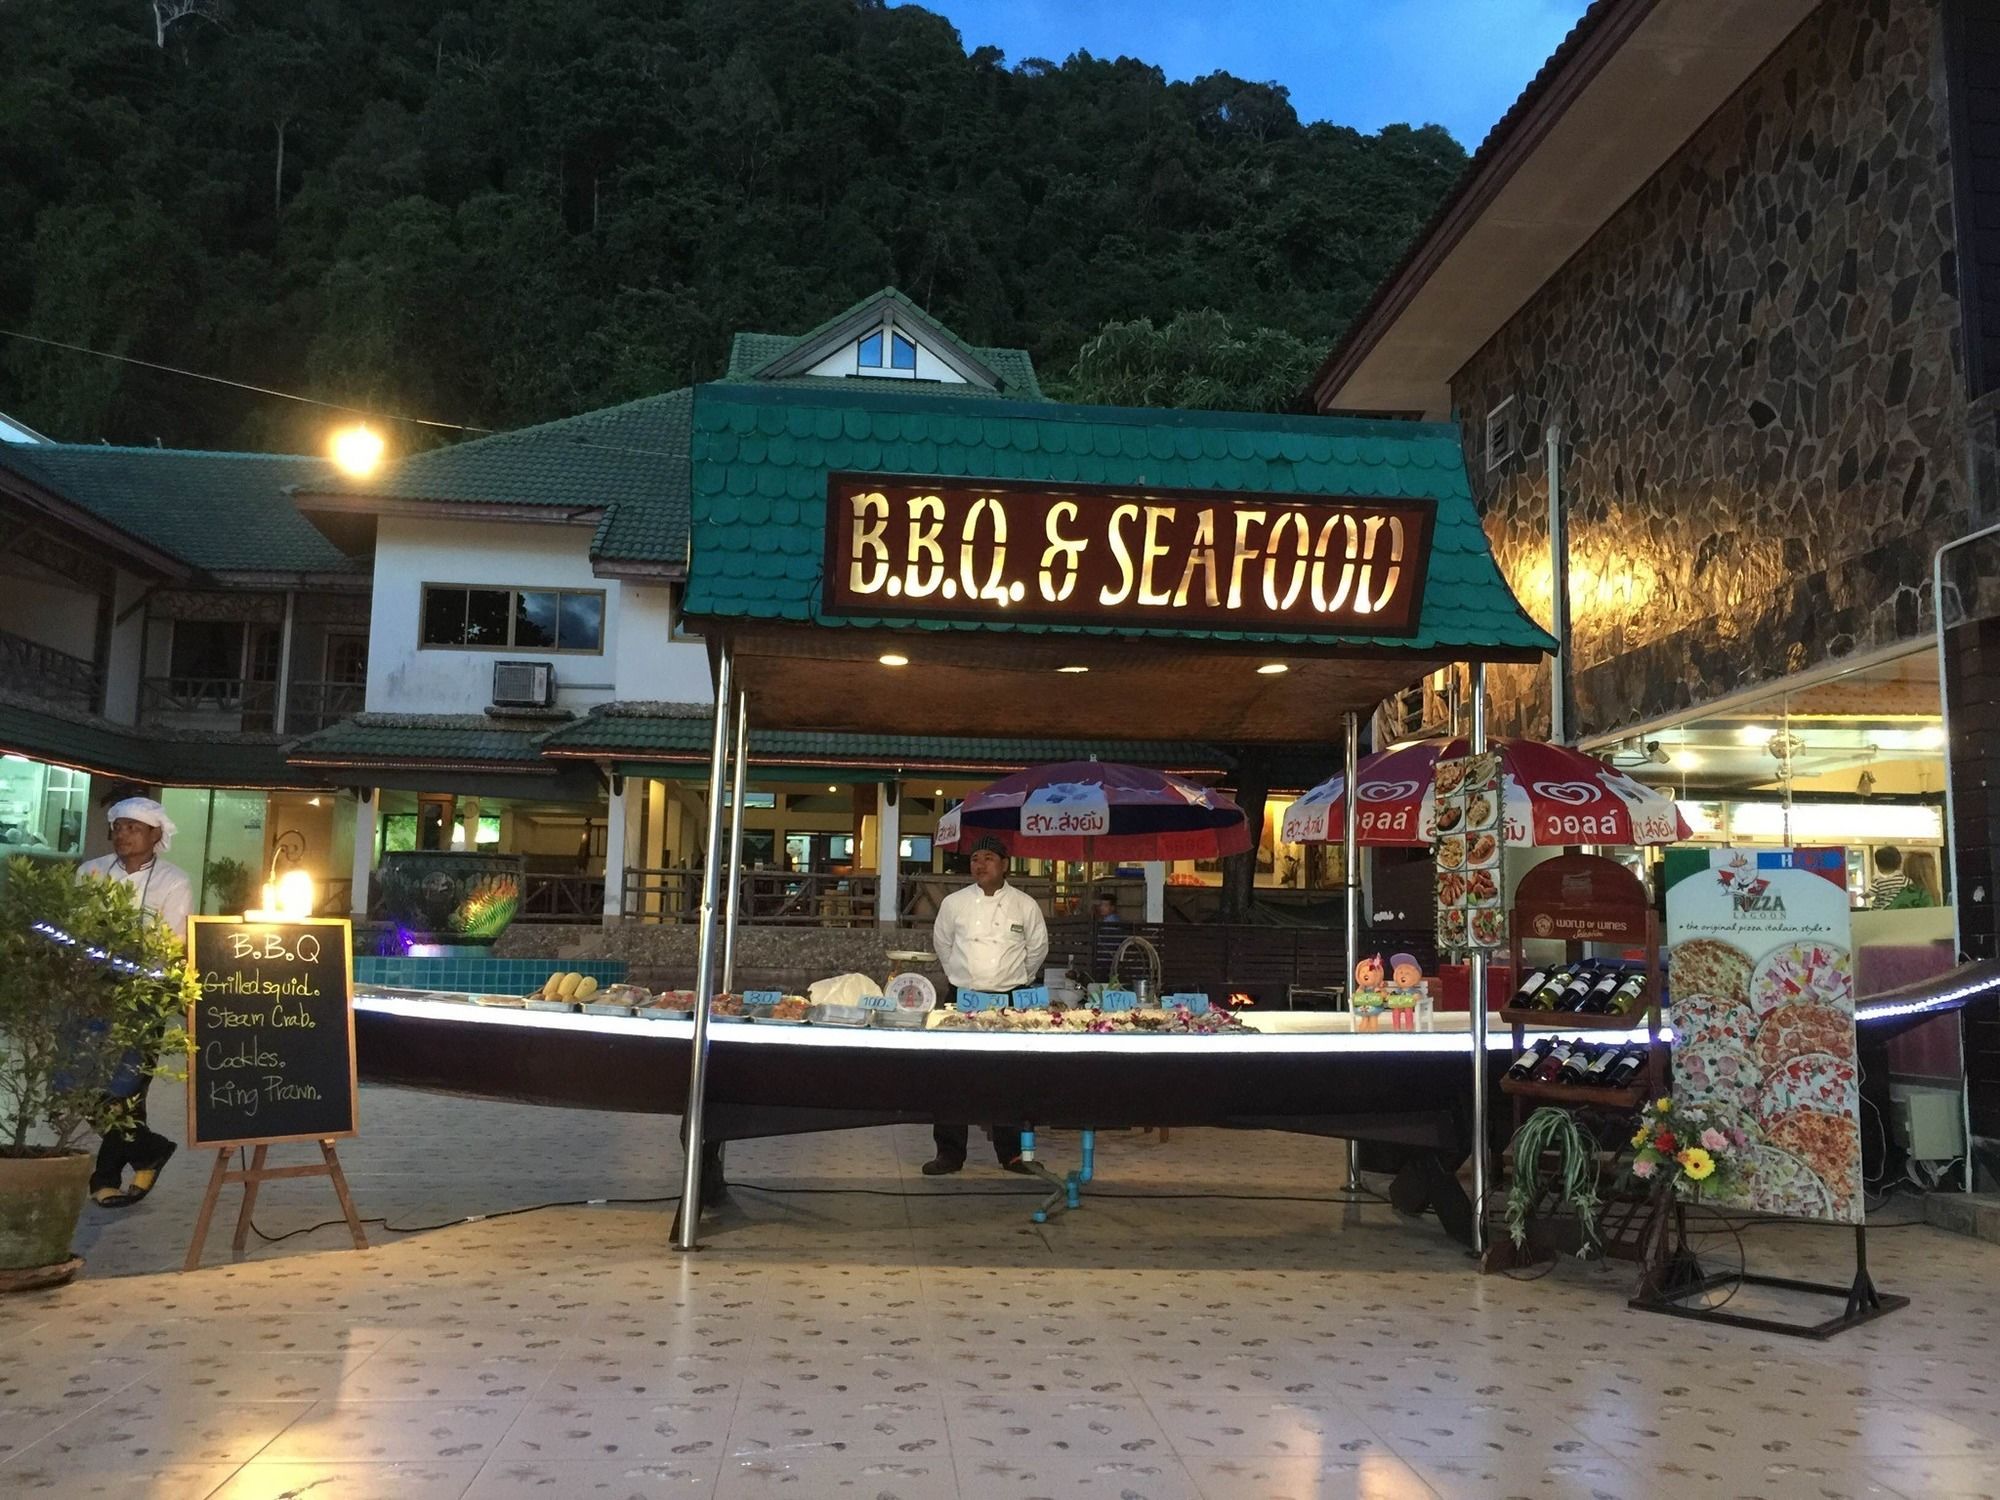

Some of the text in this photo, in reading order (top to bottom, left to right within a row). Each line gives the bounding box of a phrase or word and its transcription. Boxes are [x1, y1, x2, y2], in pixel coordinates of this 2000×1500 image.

[849, 492, 1405, 614] B.B.Q. & SEAFOOD
[1356, 806, 1412, 830] อลล์
[1548, 809, 1618, 835] วอลล์
[1733, 895, 1786, 912] PIZZA
[1733, 911, 1787, 920] LAGOON
[1686, 921, 1698, 931] the
[1701, 922, 1737, 934] original
[1801, 922, 1823, 936] style
[227, 933, 320, 964] B.B.Q
[207, 1002, 316, 1029] Steam Crab.
[205, 1035, 286, 1070] Cockles.
[262, 1075, 321, 1102] Prawn.
